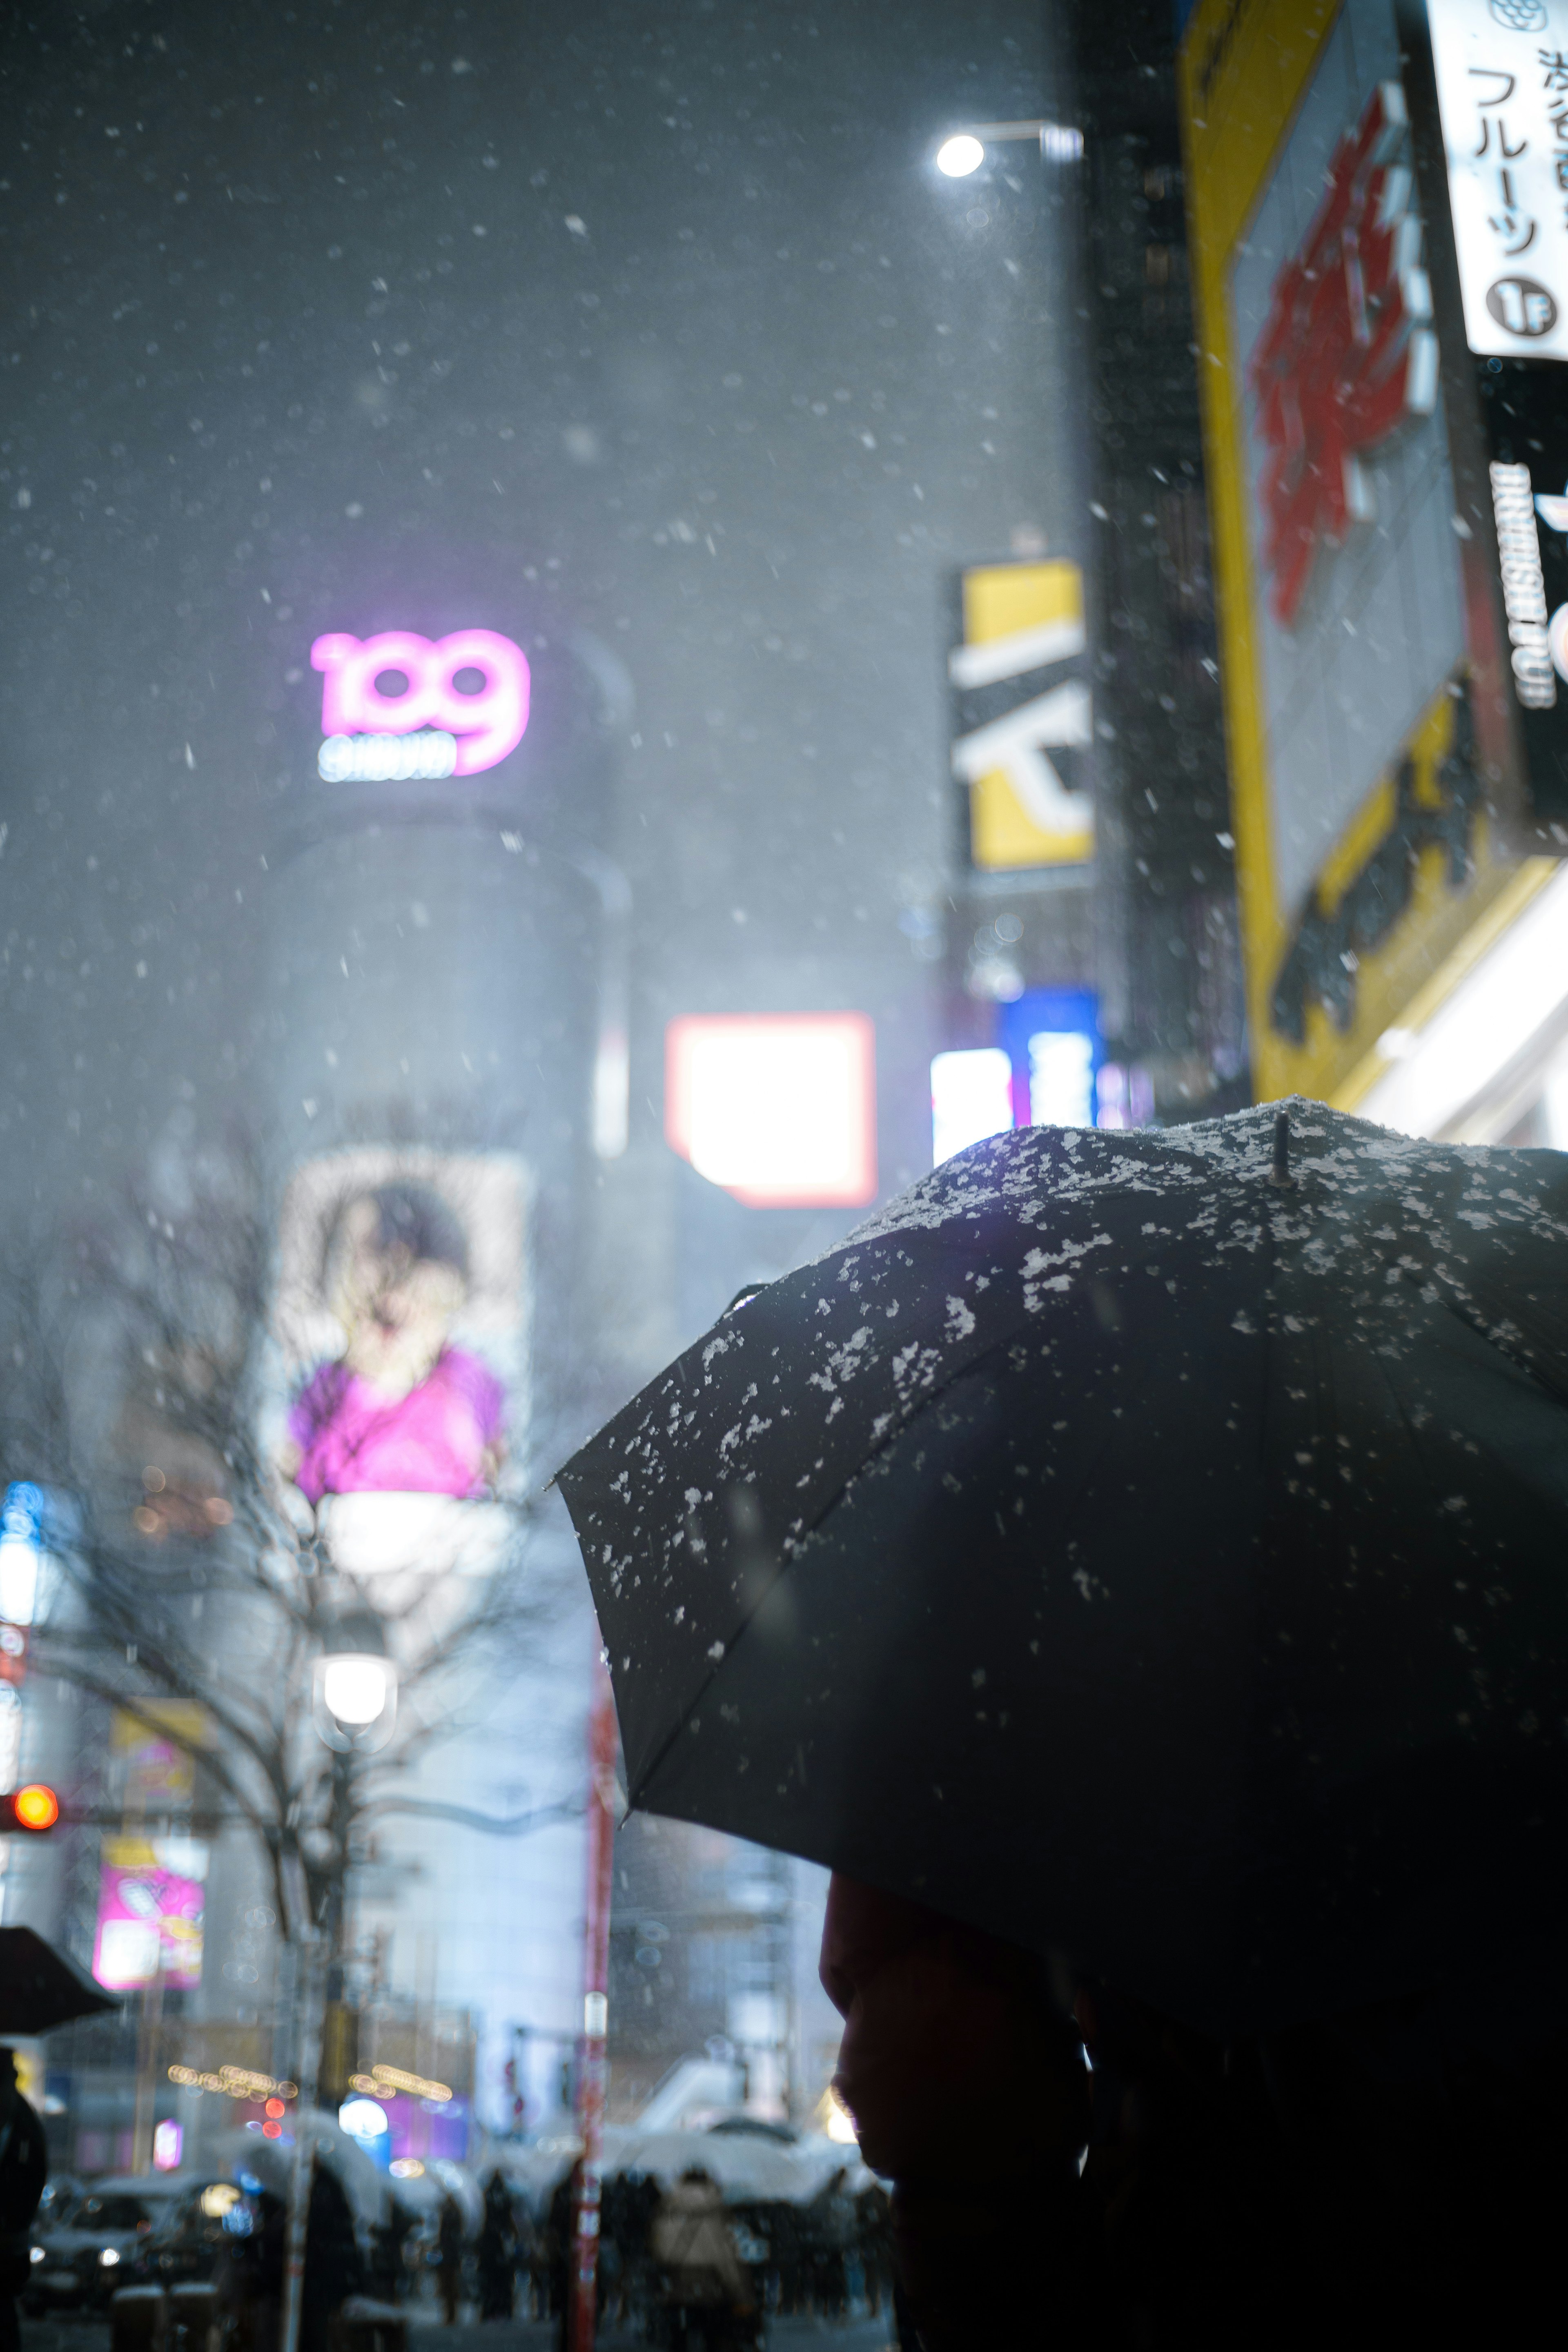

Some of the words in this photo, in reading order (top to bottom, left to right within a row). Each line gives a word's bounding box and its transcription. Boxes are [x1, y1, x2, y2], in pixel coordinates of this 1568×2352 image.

[1469, 67, 1537, 257] フルーツ
[1495, 281, 1550, 333] 1F
[310, 629, 531, 777] 109
